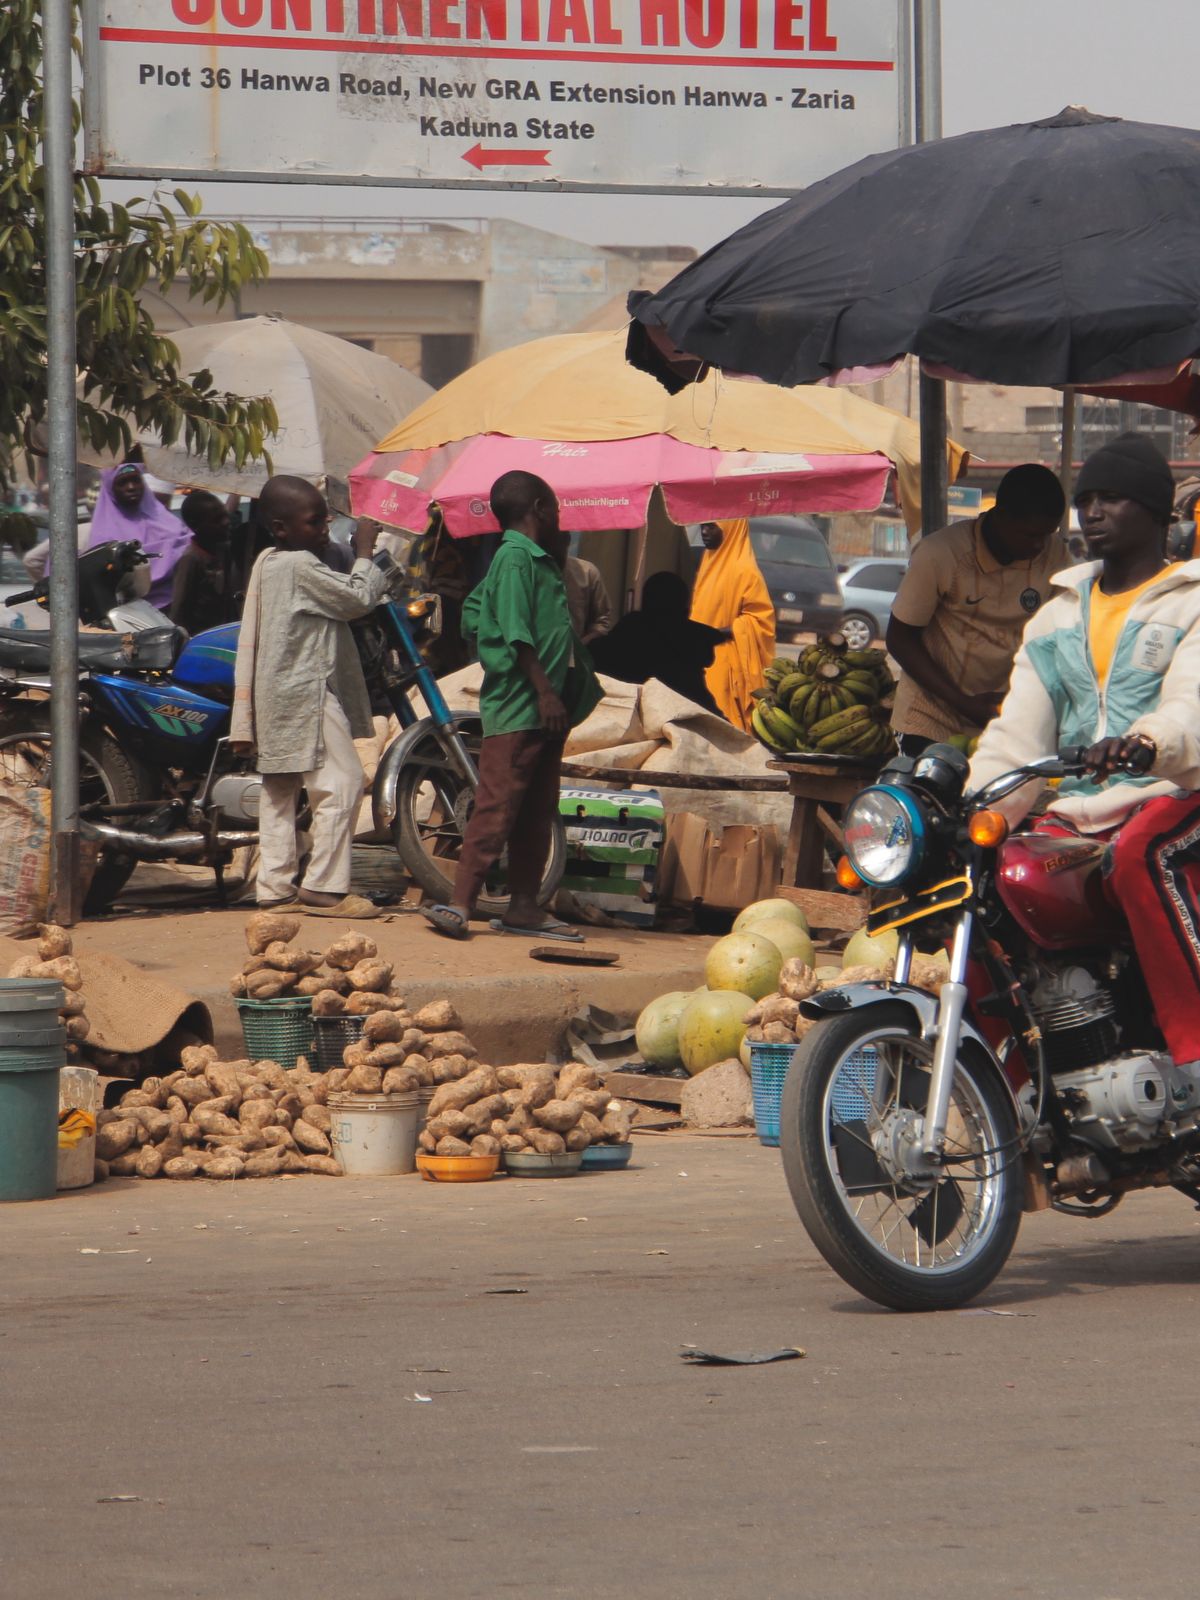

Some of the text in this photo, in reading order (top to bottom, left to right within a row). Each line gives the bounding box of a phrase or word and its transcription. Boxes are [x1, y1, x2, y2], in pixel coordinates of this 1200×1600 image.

[139, 63, 191, 87] Plot
[200, 67, 232, 89] 36
[241, 68, 330, 93] Hanwa
[339, 72, 410, 100] Road,
[419, 76, 477, 99] New
[485, 78, 541, 101] GRA
[550, 80, 676, 106] Extension
[684, 86, 768, 108] Hanwa
[791, 88, 855, 110] Zaria
[420, 115, 595, 140] Kaduna State
[541, 443, 589, 457] Hair
[563, 496, 630, 508] LushHairNigeria
[750, 489, 781, 501] LUSH
[577, 830, 628, 844] DUTOIT
[1177, 902, 1190, 921] LOVE
[1184, 921, 1196, 940] LOVE
